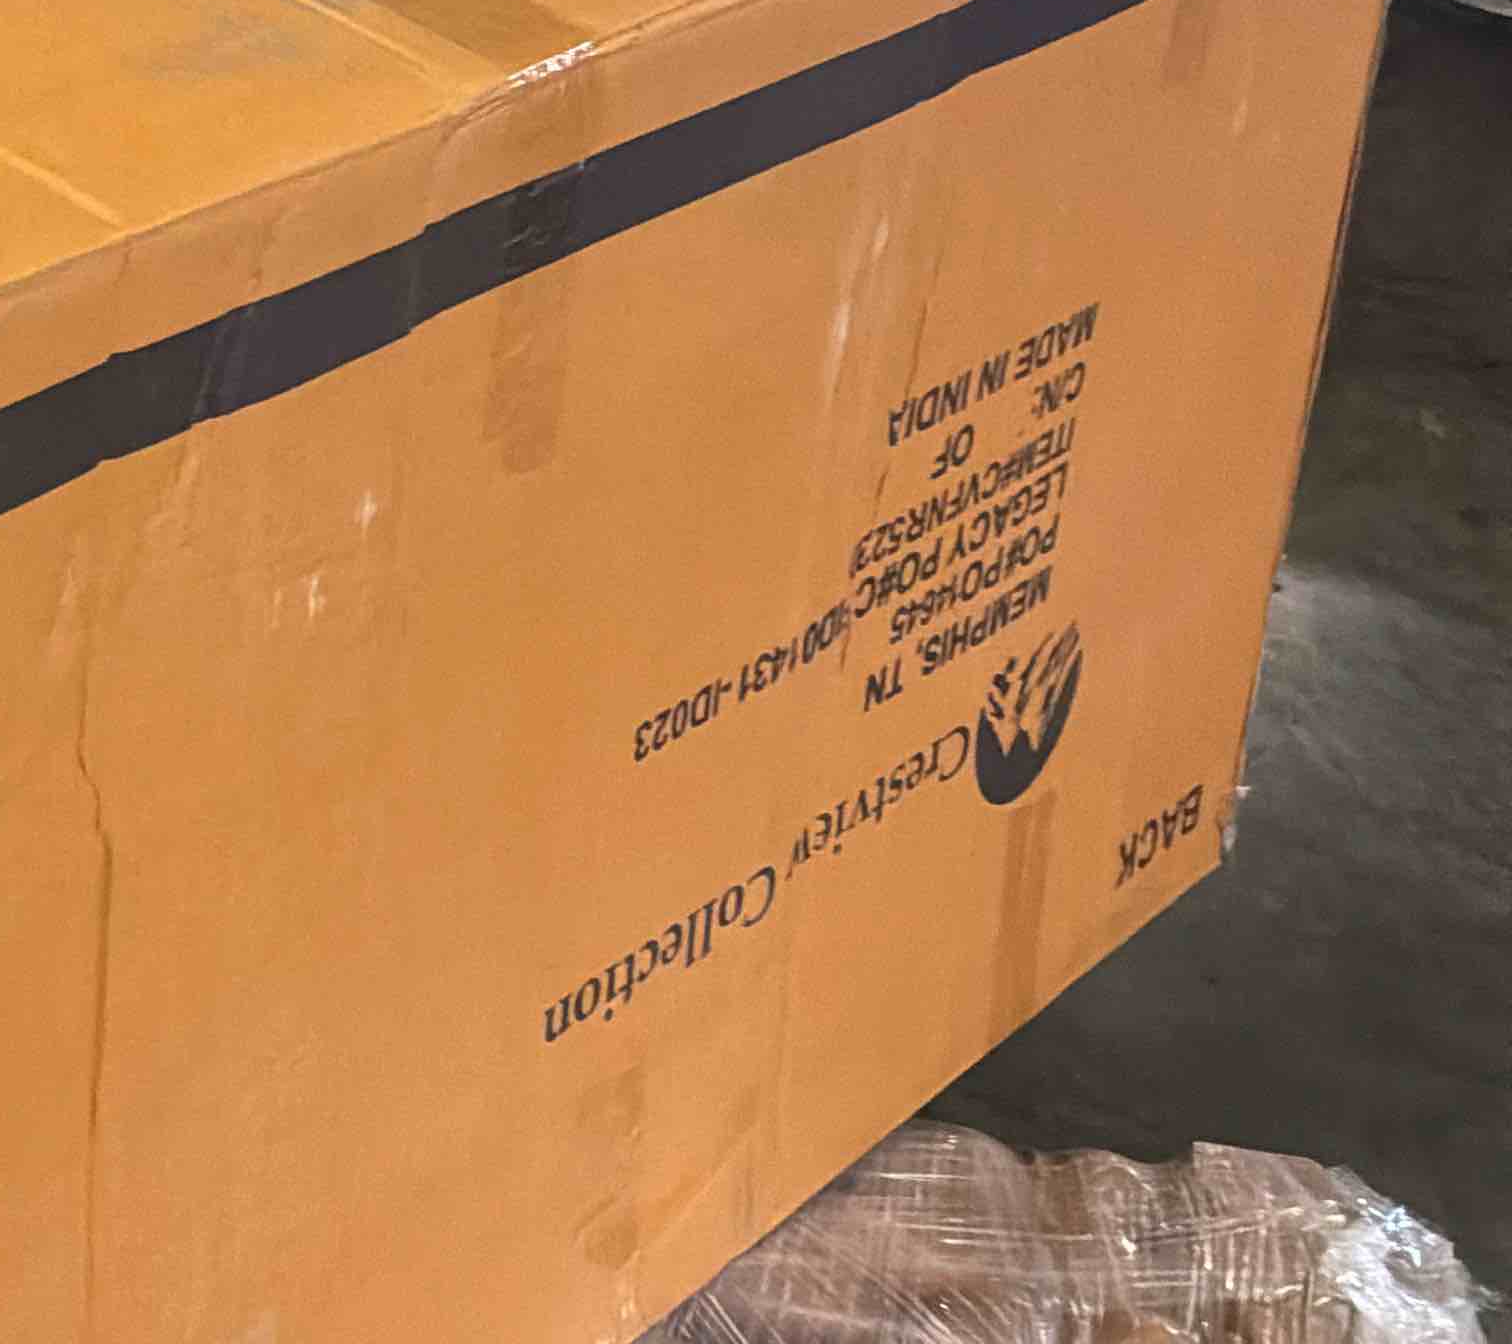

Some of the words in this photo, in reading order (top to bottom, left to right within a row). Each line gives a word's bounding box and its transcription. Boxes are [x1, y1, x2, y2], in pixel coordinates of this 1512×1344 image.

[976, 349, 1009, 402] IN
[1014, 301, 1100, 381] MADE
[888, 368, 972, 447] INDIA
[929, 424, 975, 481] OF
[947, 461, 1069, 566] LEGACY
[916, 565, 1052, 677] MEMPHIS,
[863, 657, 904, 713] TN
[784, 725, 969, 882] Crestview
[1114, 784, 1203, 889] BACK
[544, 866, 778, 1044] Collection
